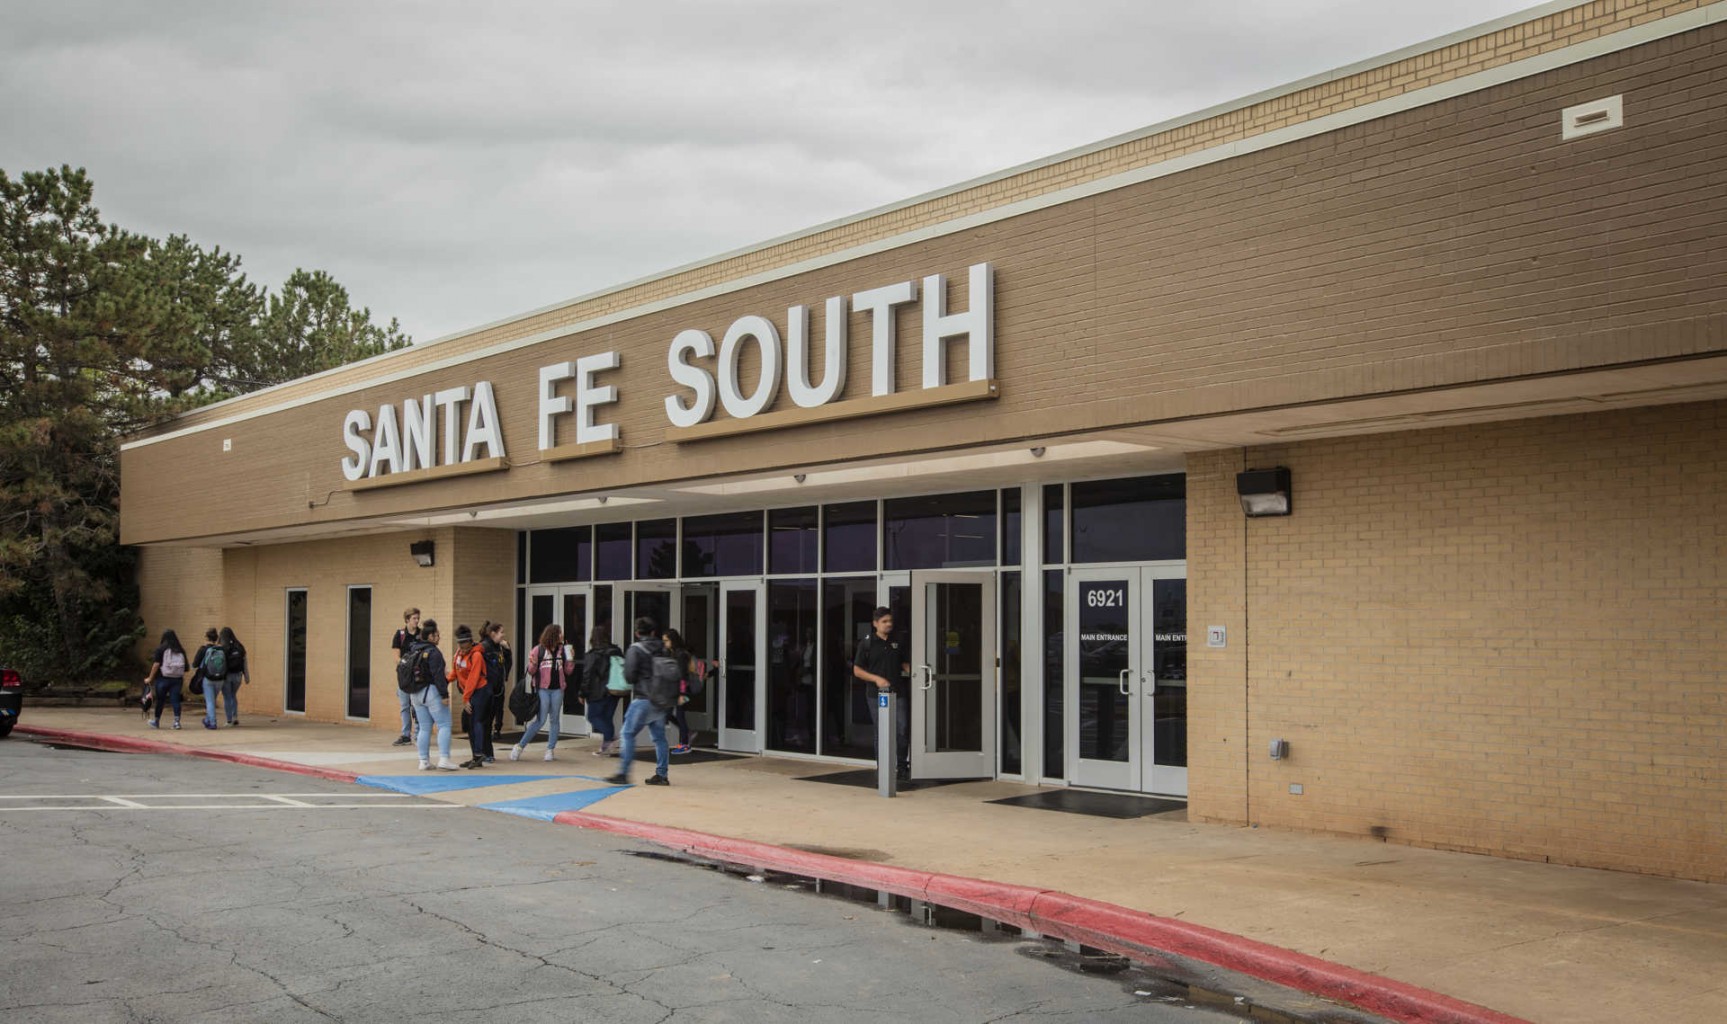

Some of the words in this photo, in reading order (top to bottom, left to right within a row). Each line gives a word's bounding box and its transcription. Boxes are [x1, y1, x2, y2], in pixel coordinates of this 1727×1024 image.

[341, 381, 505, 481] SANTA
[539, 351, 620, 450] FE
[664, 263, 995, 428] SOUTH
[1087, 589, 1123, 607] 6921
[1081, 633, 1096, 641] MAIN
[1097, 633, 1128, 641] ENTRANCE
[1155, 633, 1171, 641] MAIN
